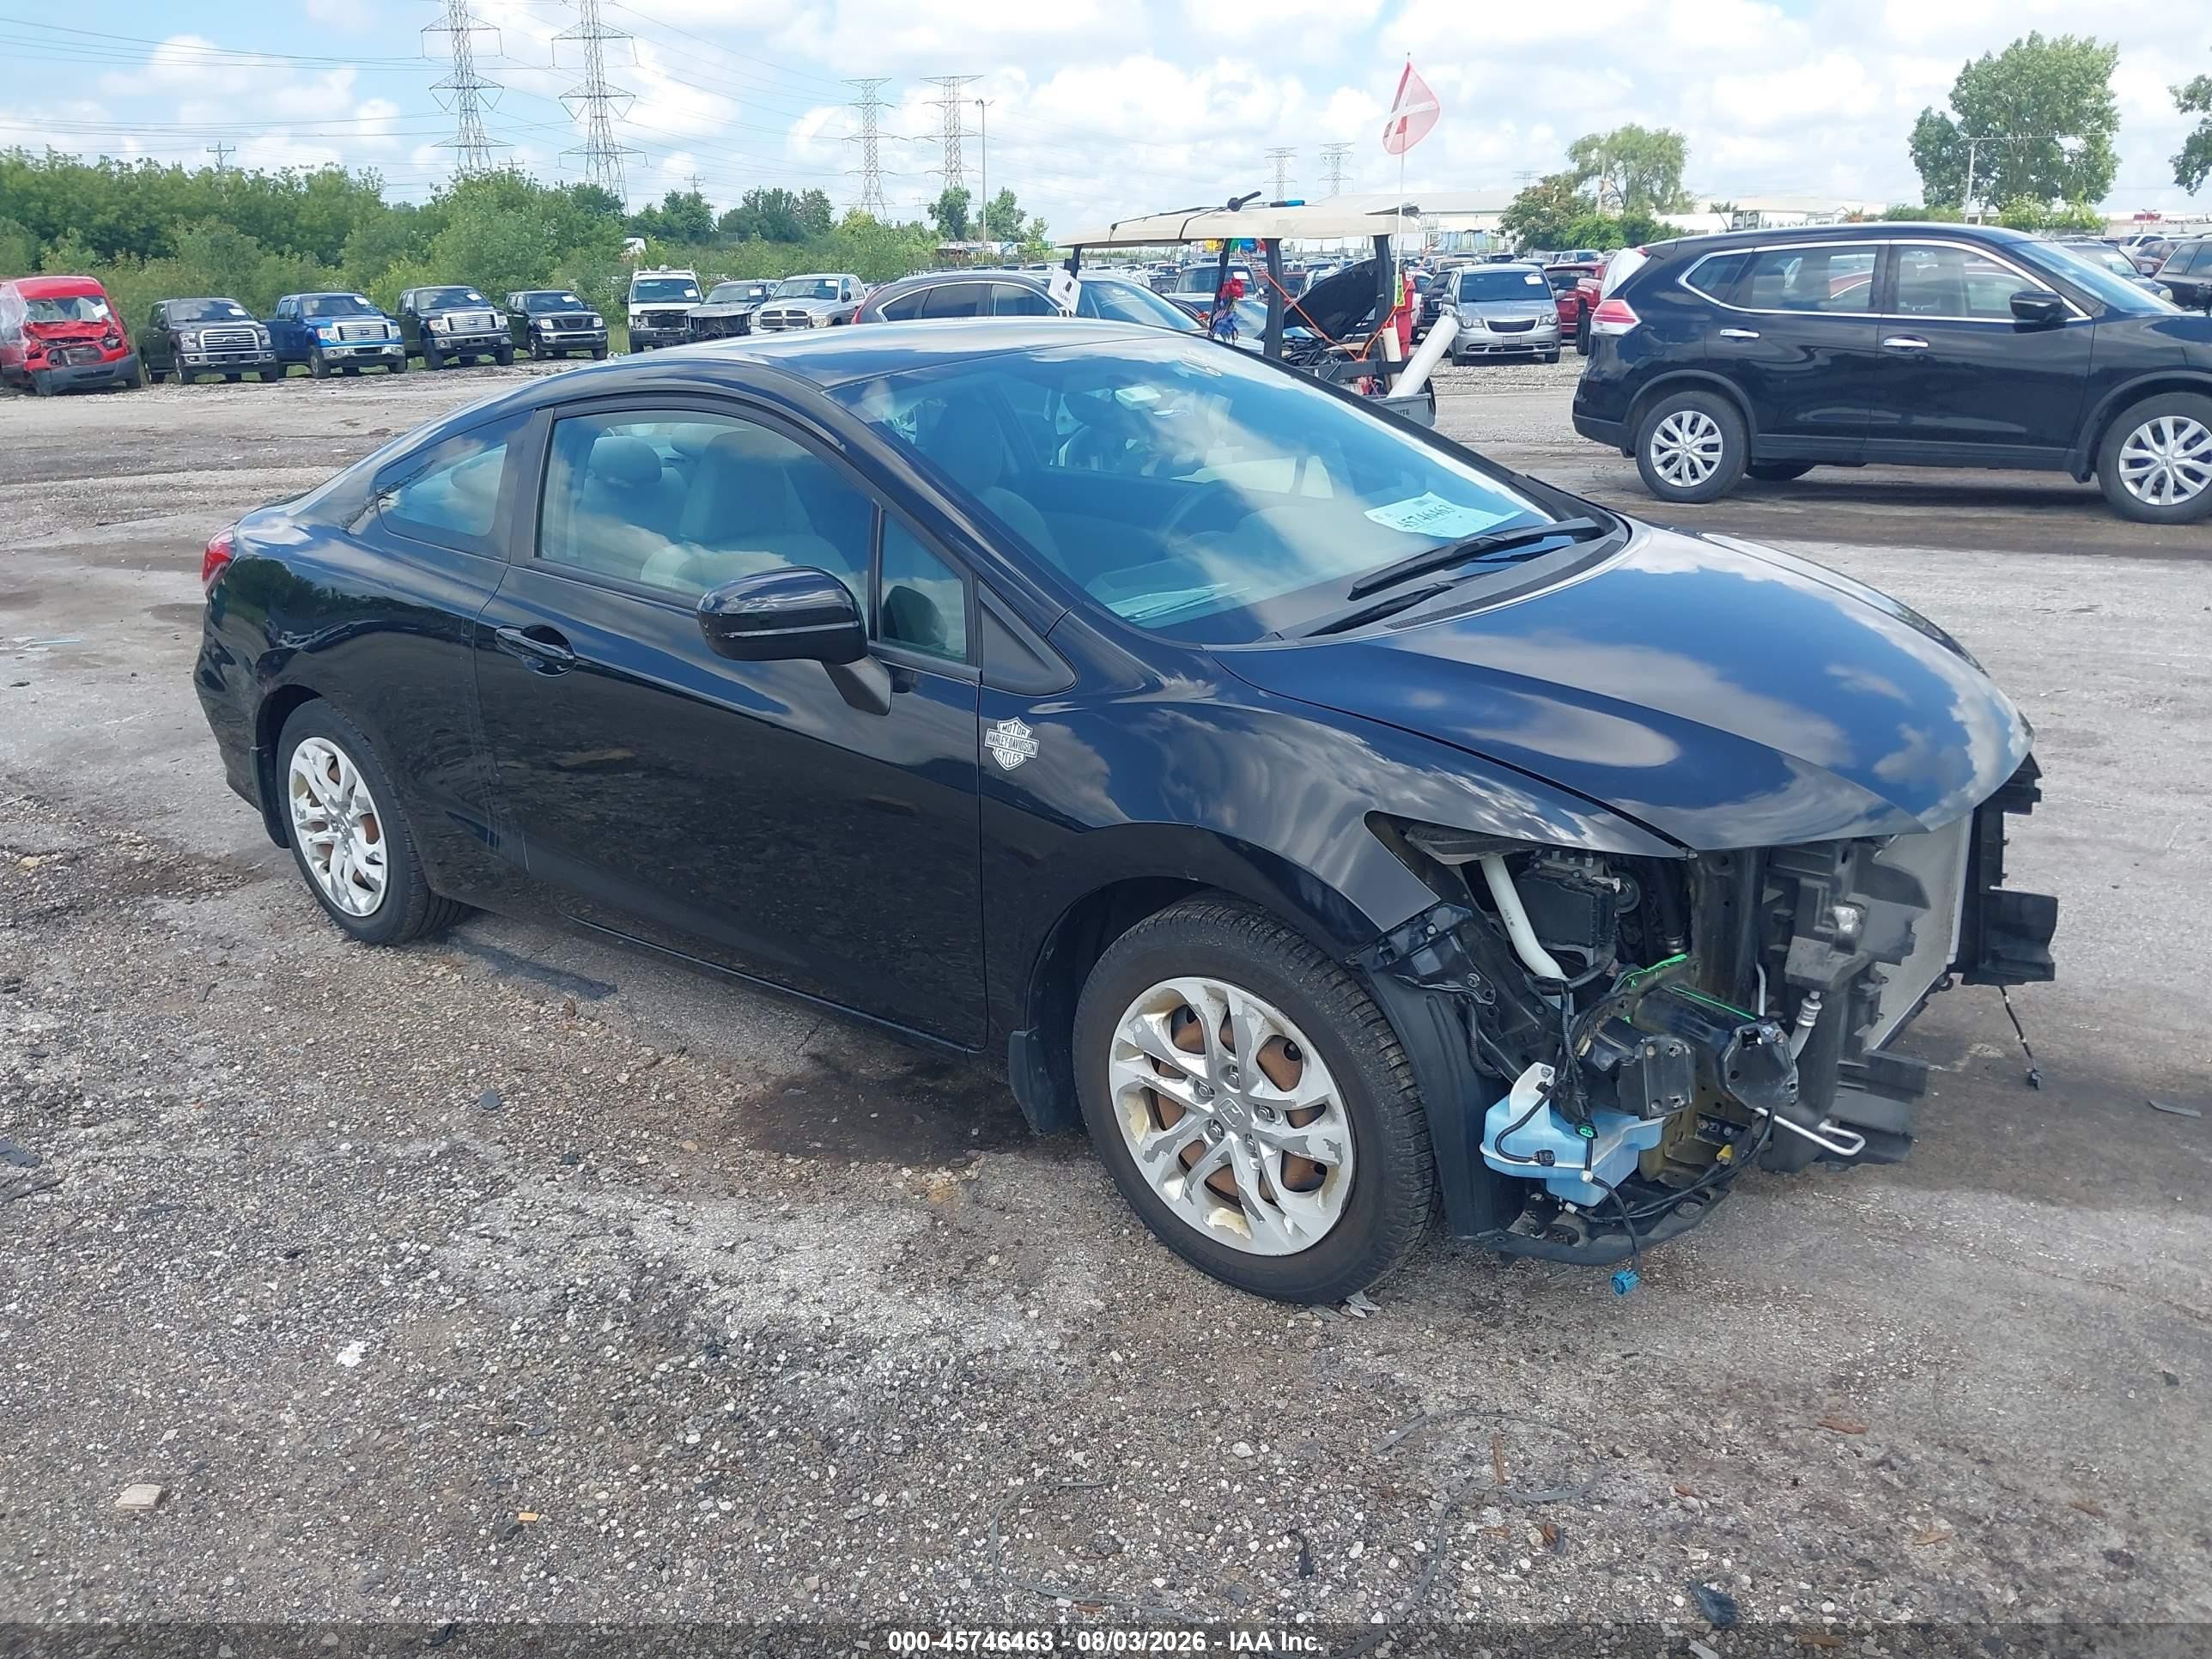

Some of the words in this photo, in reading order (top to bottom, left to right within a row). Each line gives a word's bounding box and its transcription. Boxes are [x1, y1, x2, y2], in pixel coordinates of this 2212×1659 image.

[1001, 721, 1027, 737] MOTOR
[988, 732, 1036, 755] HARLEY-DAVIDSON
[997, 749, 1022, 766] CYCLES
